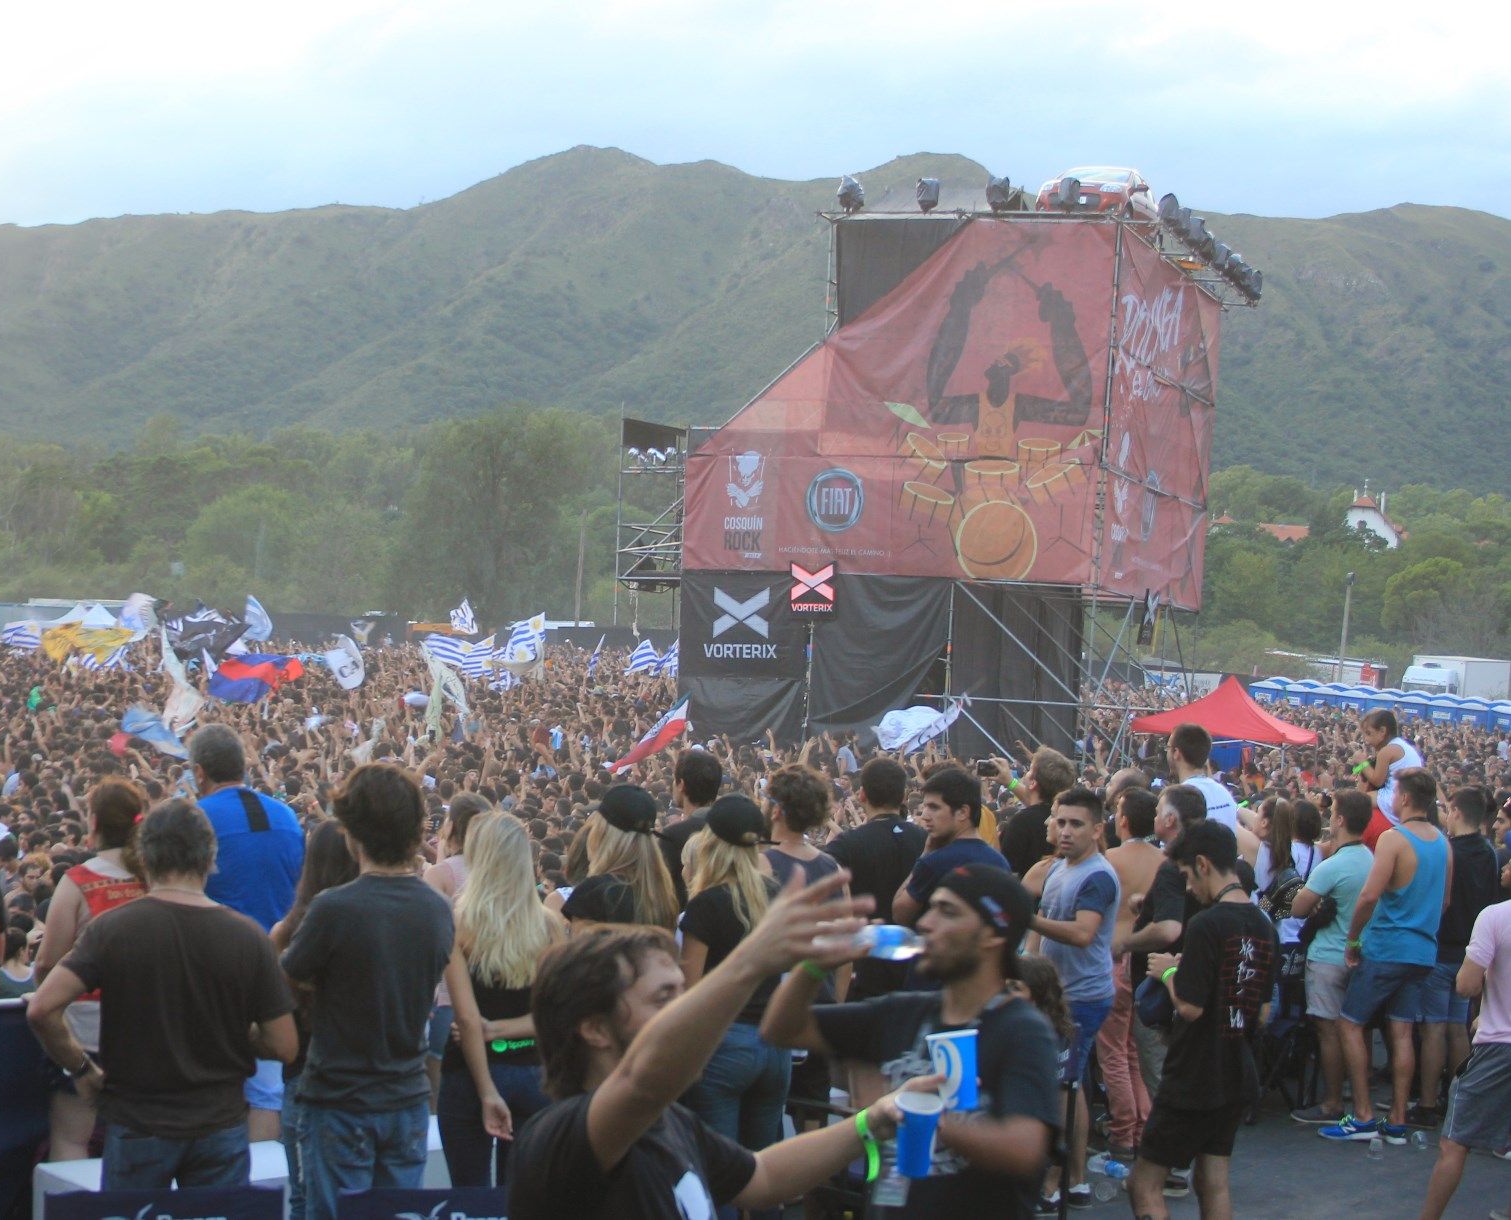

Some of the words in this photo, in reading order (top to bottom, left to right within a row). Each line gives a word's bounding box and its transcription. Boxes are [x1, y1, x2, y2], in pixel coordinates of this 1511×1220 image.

[820, 487, 852, 515] FIAT
[724, 515, 763, 531] COSQUÍN
[723, 531, 762, 551] ROCK
[791, 603, 833, 613] VORTERIX
[703, 643, 778, 659] VORTERIX
